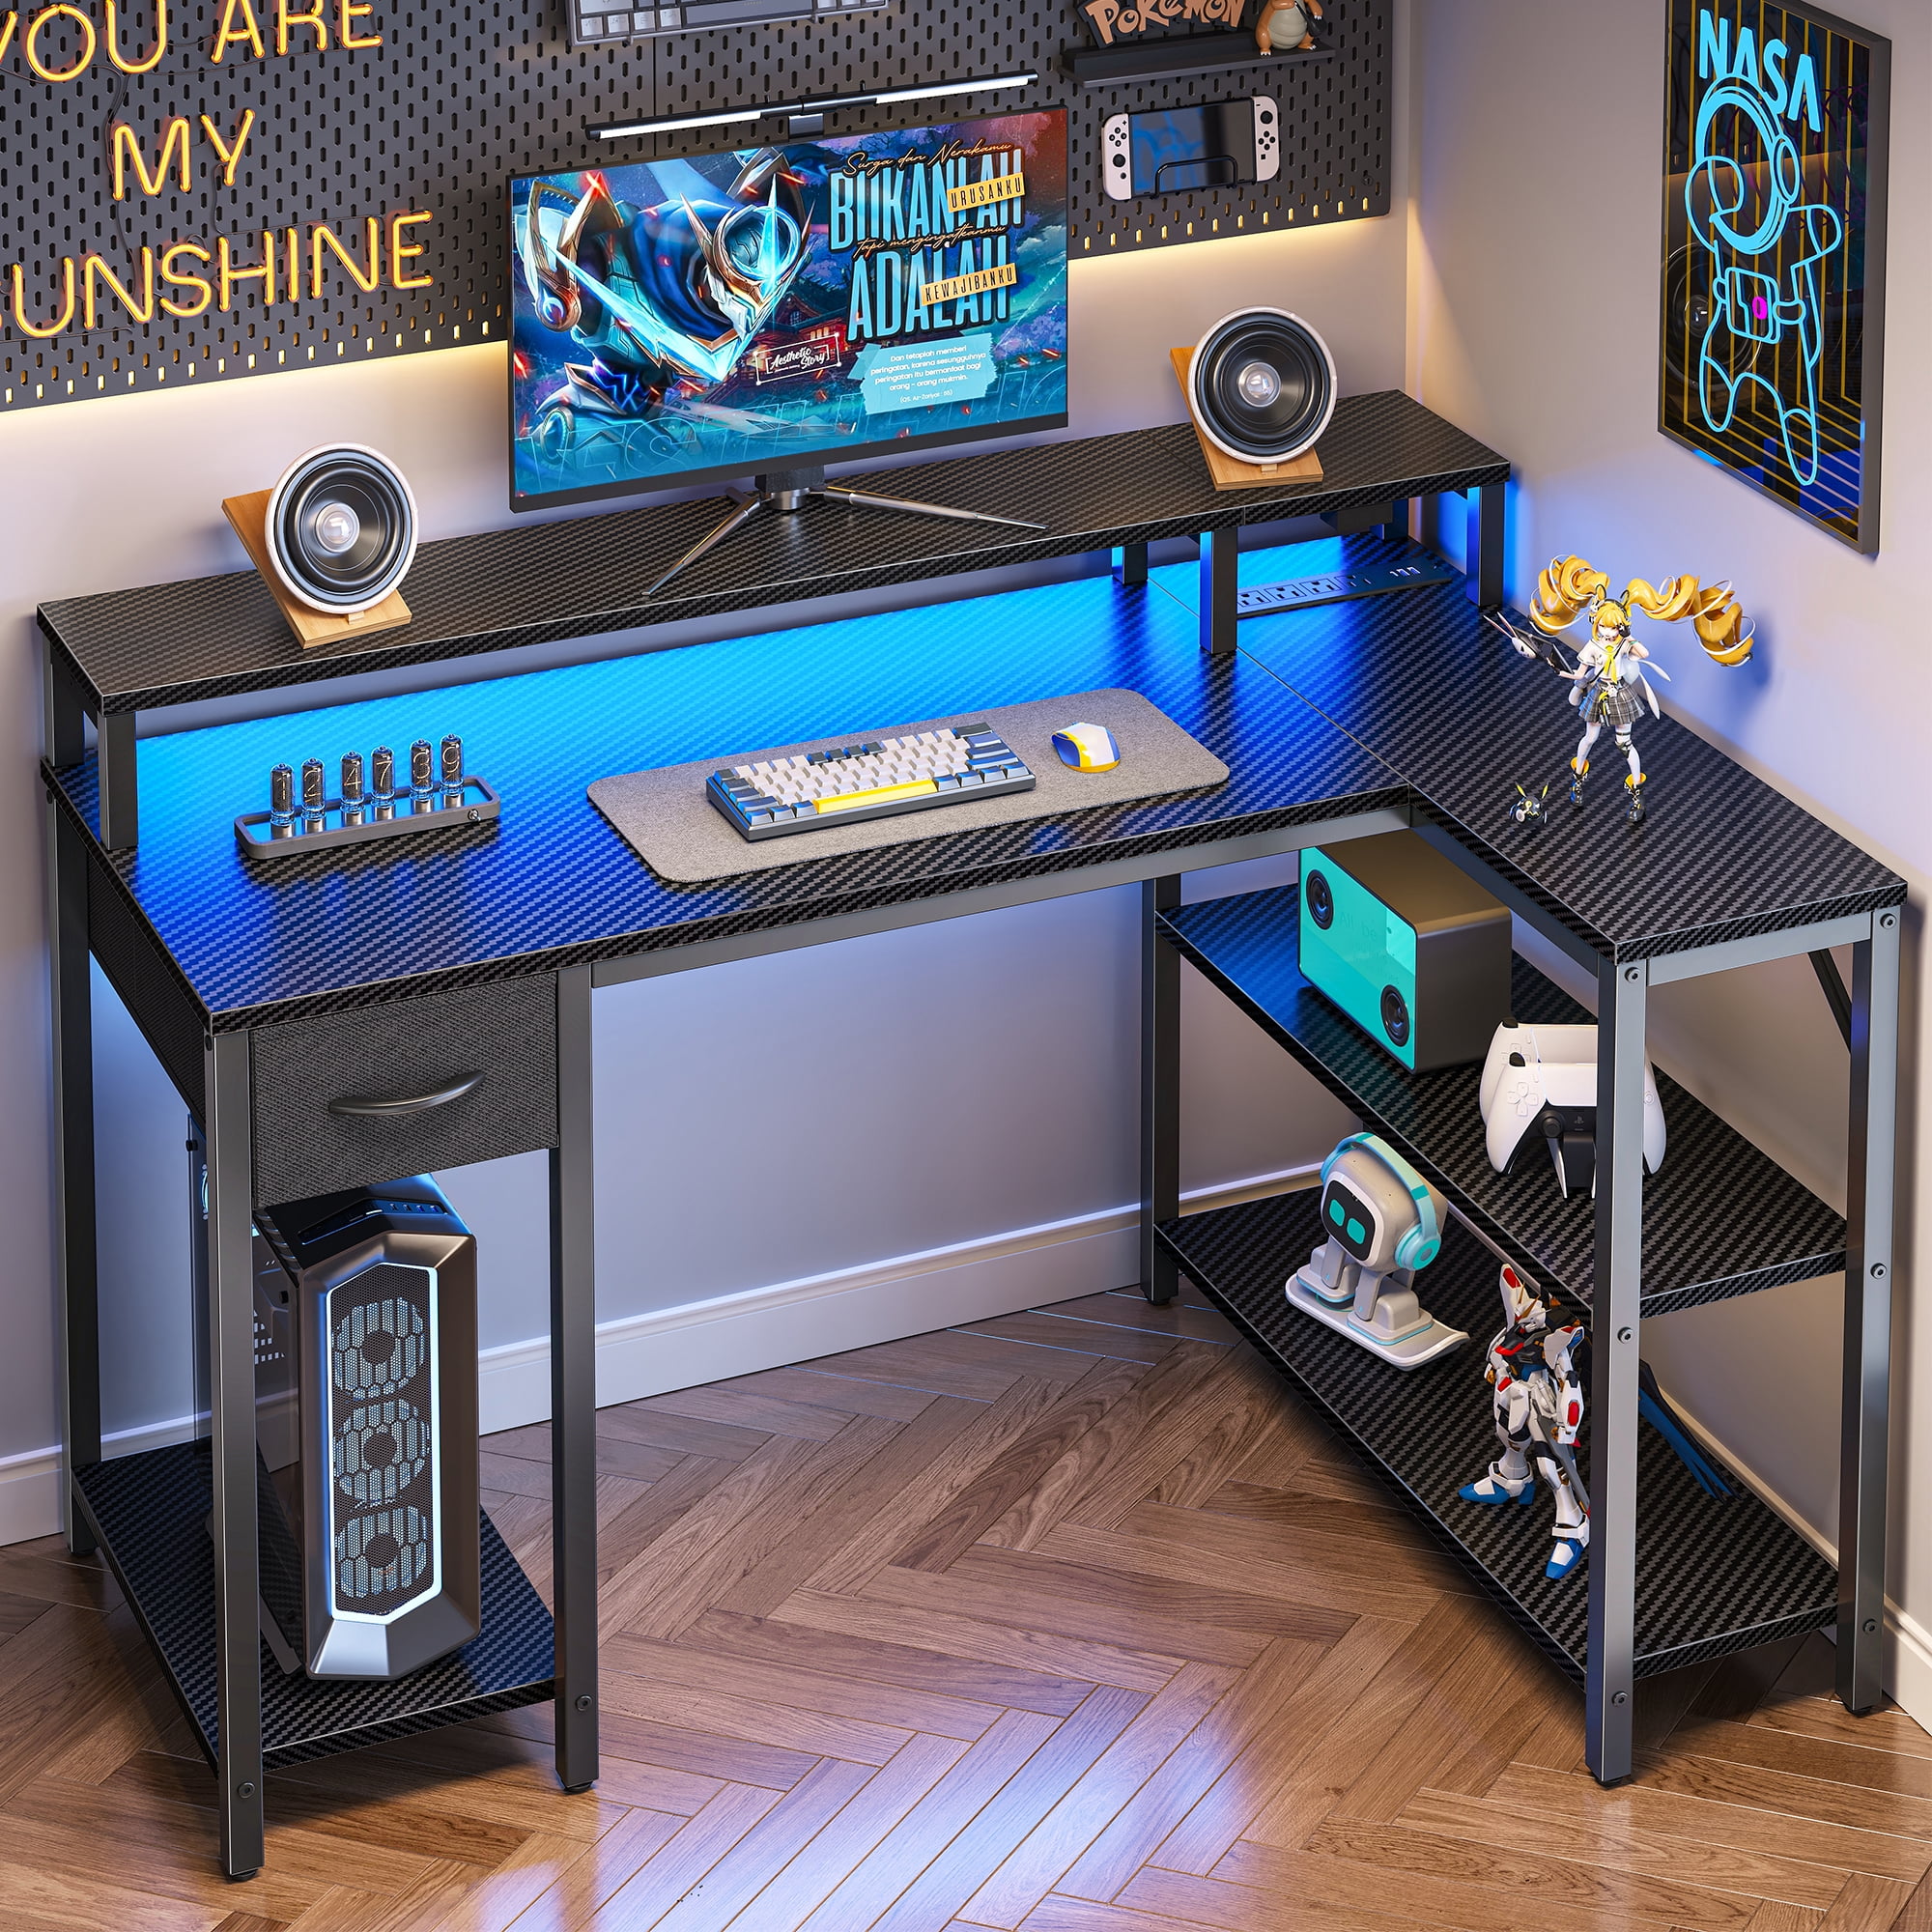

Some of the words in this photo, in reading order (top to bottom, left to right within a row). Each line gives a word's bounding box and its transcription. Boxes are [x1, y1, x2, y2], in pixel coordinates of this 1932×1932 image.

[211, 0, 384, 63] ARE
[1699, 9, 1824, 132] NASA
[112, 109, 256, 201] MY
[951, 177, 1022, 209] URUSANKU
[0, 210, 434, 338] UNSHINE
[925, 268, 1013, 301] KEWAJIBANKU
[770, 346, 811, 370] Aesthetic
[801, 353, 825, 369] Story
